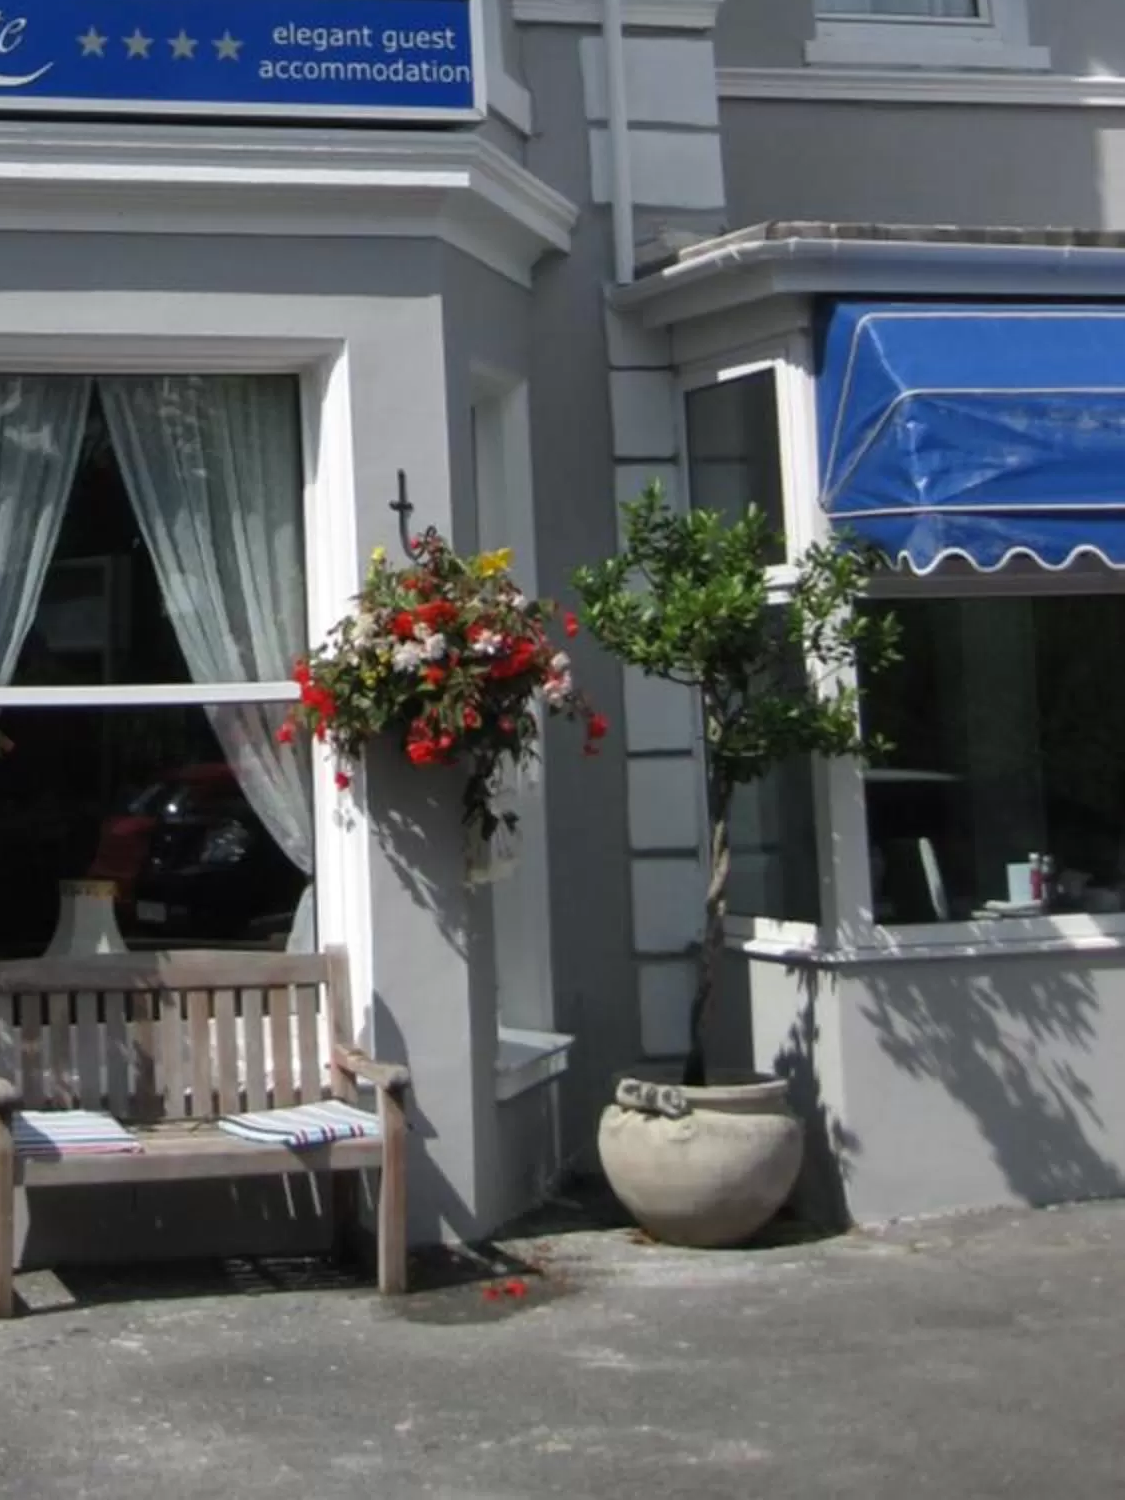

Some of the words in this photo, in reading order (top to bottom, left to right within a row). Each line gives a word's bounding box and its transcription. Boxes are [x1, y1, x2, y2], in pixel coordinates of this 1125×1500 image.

[273, 22, 373, 51] elegant
[382, 27, 456, 53] guest
[258, 58, 472, 83] accommodation
